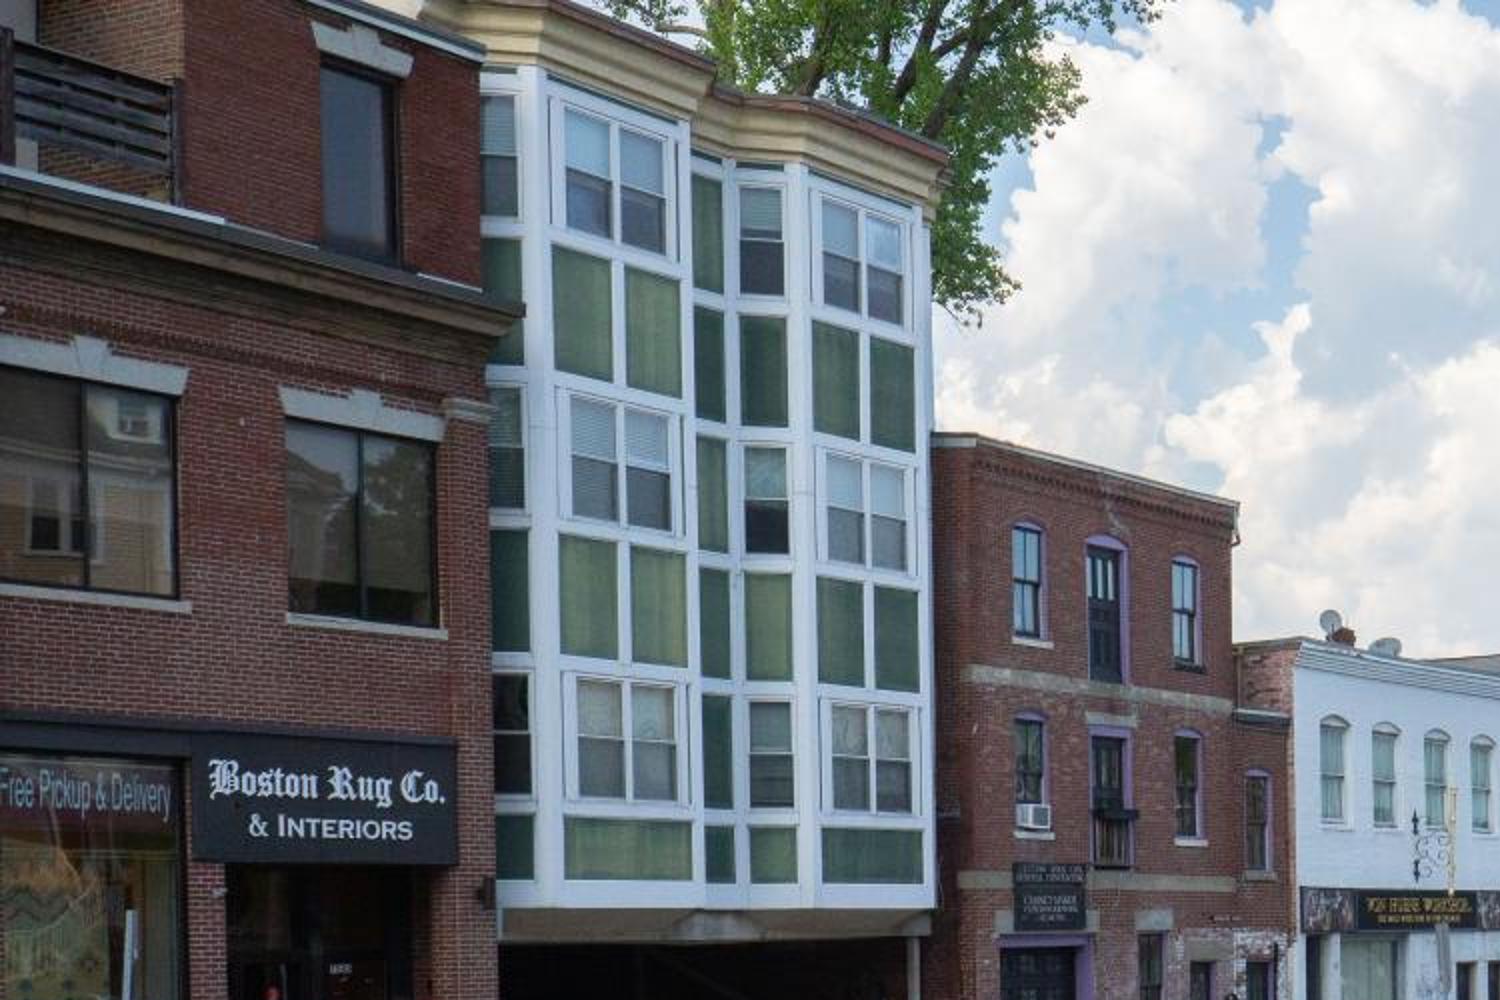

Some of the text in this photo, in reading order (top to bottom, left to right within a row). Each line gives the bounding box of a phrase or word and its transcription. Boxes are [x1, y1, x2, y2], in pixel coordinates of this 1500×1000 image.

[39, 768, 91, 820] Pickup
[95, 772, 107, 812] &
[111, 772, 171, 823] Delivery
[209, 759, 445, 808] Boston Rug Co.
[249, 813, 269, 837] &
